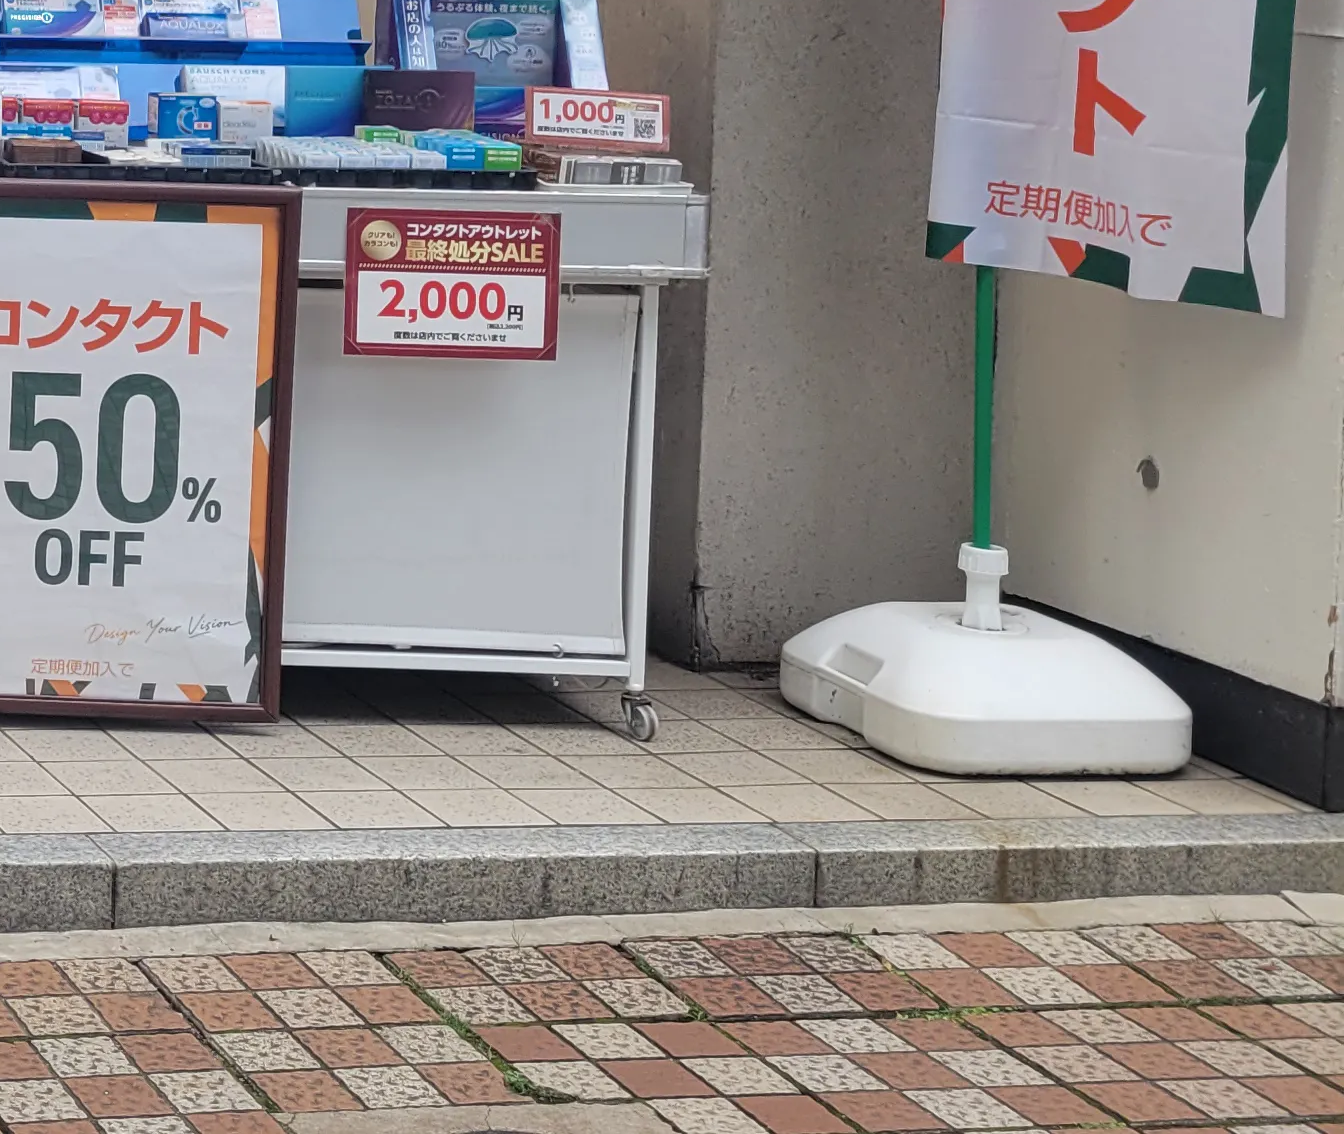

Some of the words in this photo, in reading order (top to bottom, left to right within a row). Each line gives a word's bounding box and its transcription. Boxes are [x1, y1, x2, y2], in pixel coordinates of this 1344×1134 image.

[983, 179, 1173, 249] 定期便加入で
[406, 223, 542, 241] コンタクトアウトレット
[405, 239, 545, 264] 最終処分SALE
[377, 279, 524, 324] 2,000円
[393, 331, 507, 343] 度数は店内でご覧くださいませ
[33, 529, 146, 588] OFF
[84, 622, 141, 646] Design
[146, 617, 182, 644] Your
[187, 613, 244, 639] Vision
[30, 658, 135, 678] 定期便加入で
